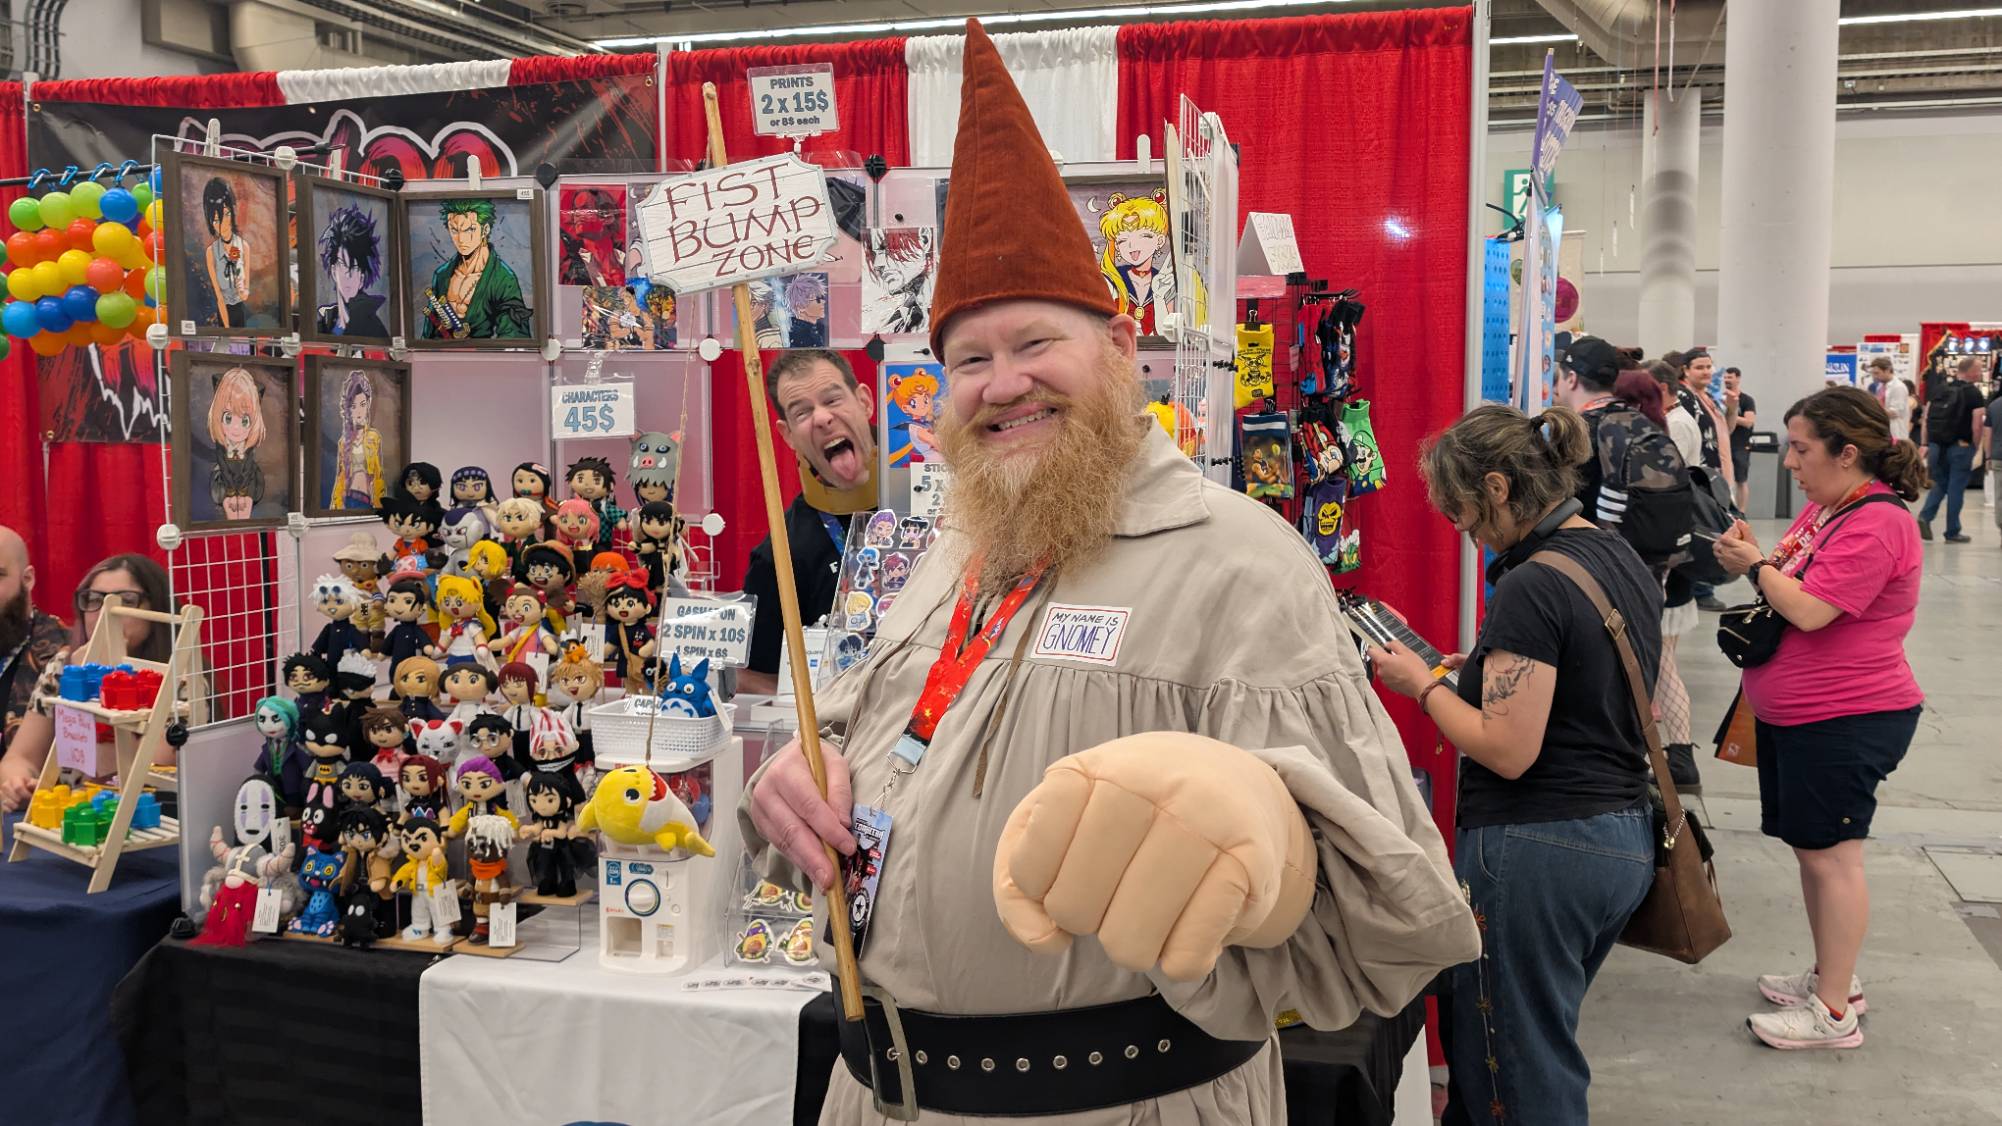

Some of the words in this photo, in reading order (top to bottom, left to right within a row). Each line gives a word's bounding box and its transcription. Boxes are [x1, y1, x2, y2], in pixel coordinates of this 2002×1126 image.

[770, 76, 814, 89] PRINTS
[761, 94, 774, 114] 2
[777, 98, 789, 113] x
[792, 89, 829, 113] 15$
[797, 116, 820, 125] each
[664, 163, 789, 221] FIST
[667, 196, 821, 265] BUMP
[711, 235, 815, 277] ZONE
[564, 404, 615, 433] 45$
[921, 475, 931, 491] 5
[677, 605, 736, 621] GASHON
[1052, 612, 1071, 623] MY
[1071, 613, 1104, 623] NAME
[1105, 617, 1118, 626] IS
[663, 624, 671, 638] 2
[674, 625, 707, 641] SPIN
[709, 630, 717, 640] x
[720, 627, 746, 644] 10$
[1043, 624, 1117, 655] GNOMEY
[683, 646, 707, 657] SPIN
